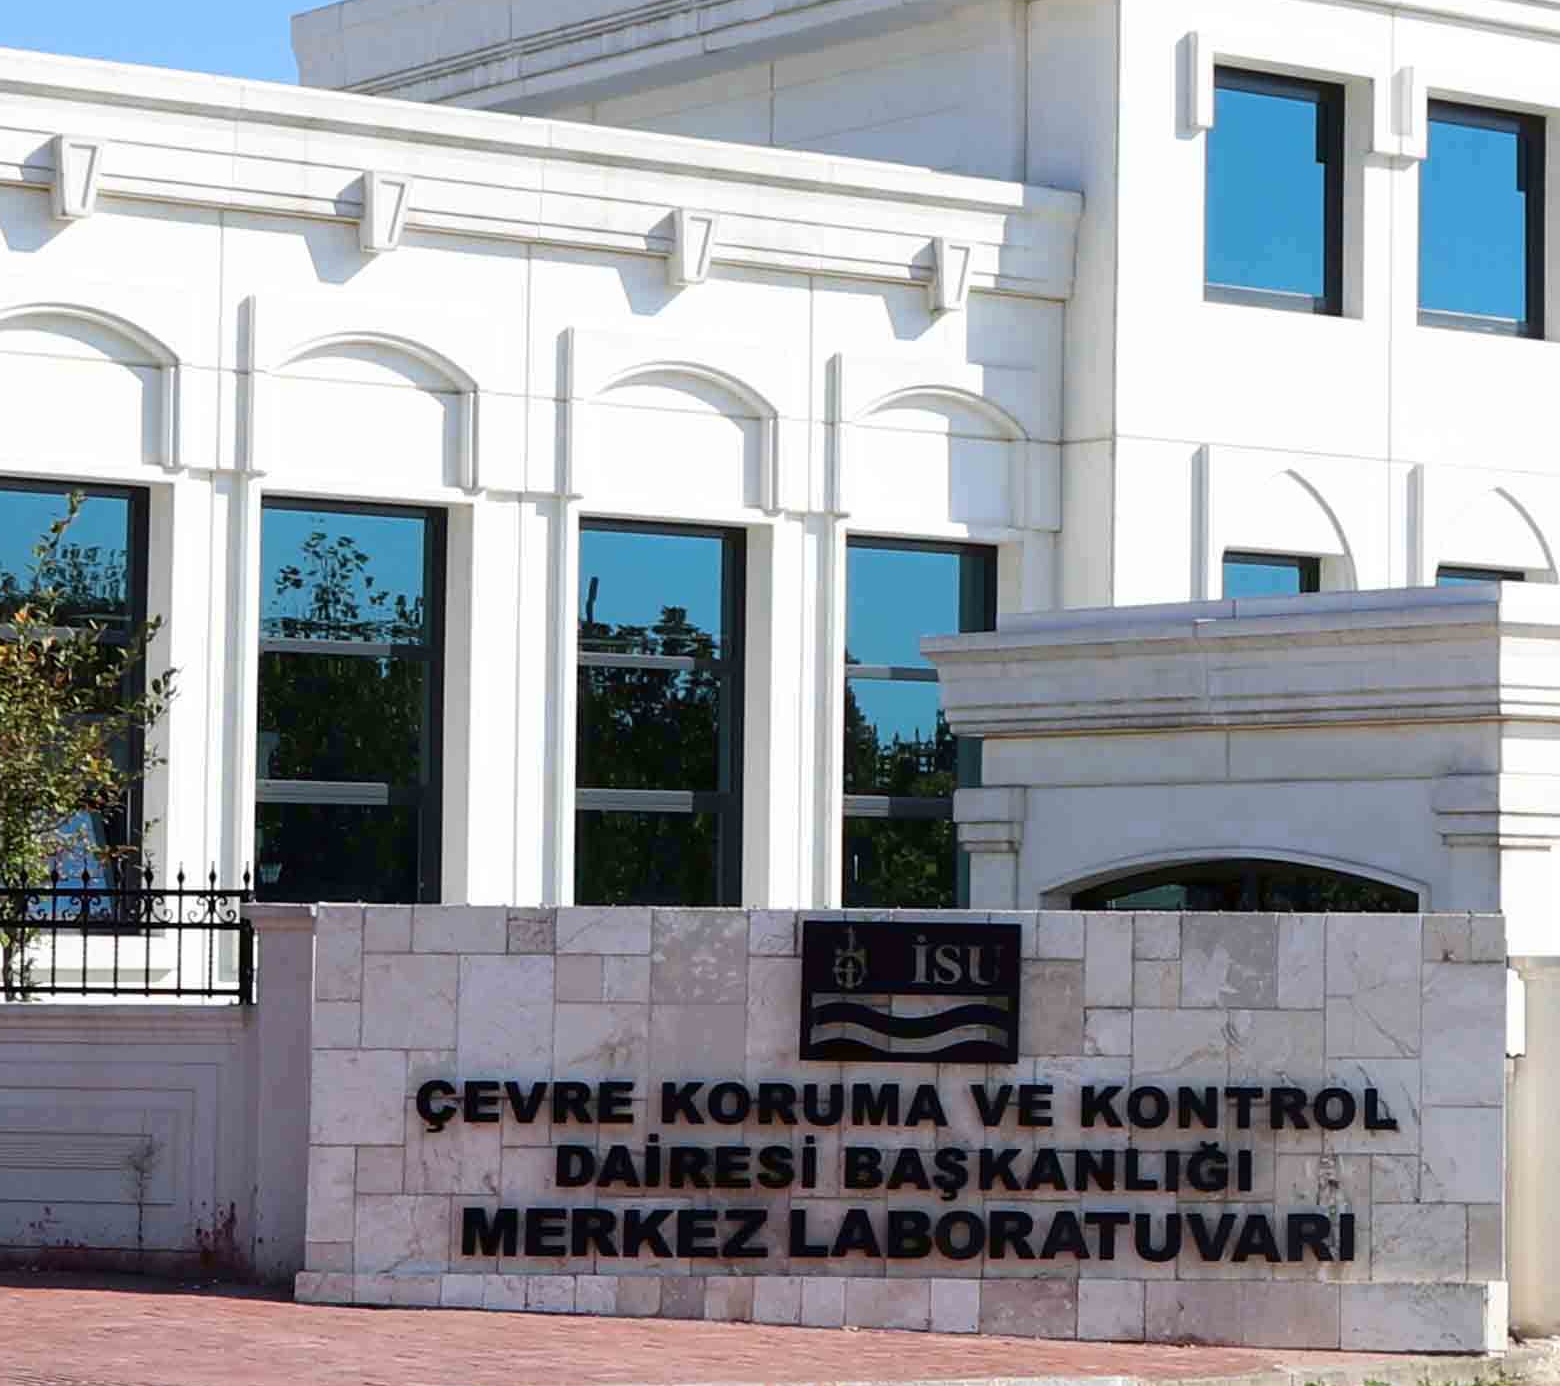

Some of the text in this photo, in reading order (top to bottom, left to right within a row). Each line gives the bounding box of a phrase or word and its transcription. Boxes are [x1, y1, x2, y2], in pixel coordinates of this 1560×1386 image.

[911, 933, 1004, 987] İSU
[416, 1080, 1400, 1133] ÇEVRE KORUMA VE KONTROL
[555, 1134, 1253, 1202] DAİRESİ BAŞKANLIĞI
[461, 1207, 1356, 1263] MERKEZ LABORATUVARI
